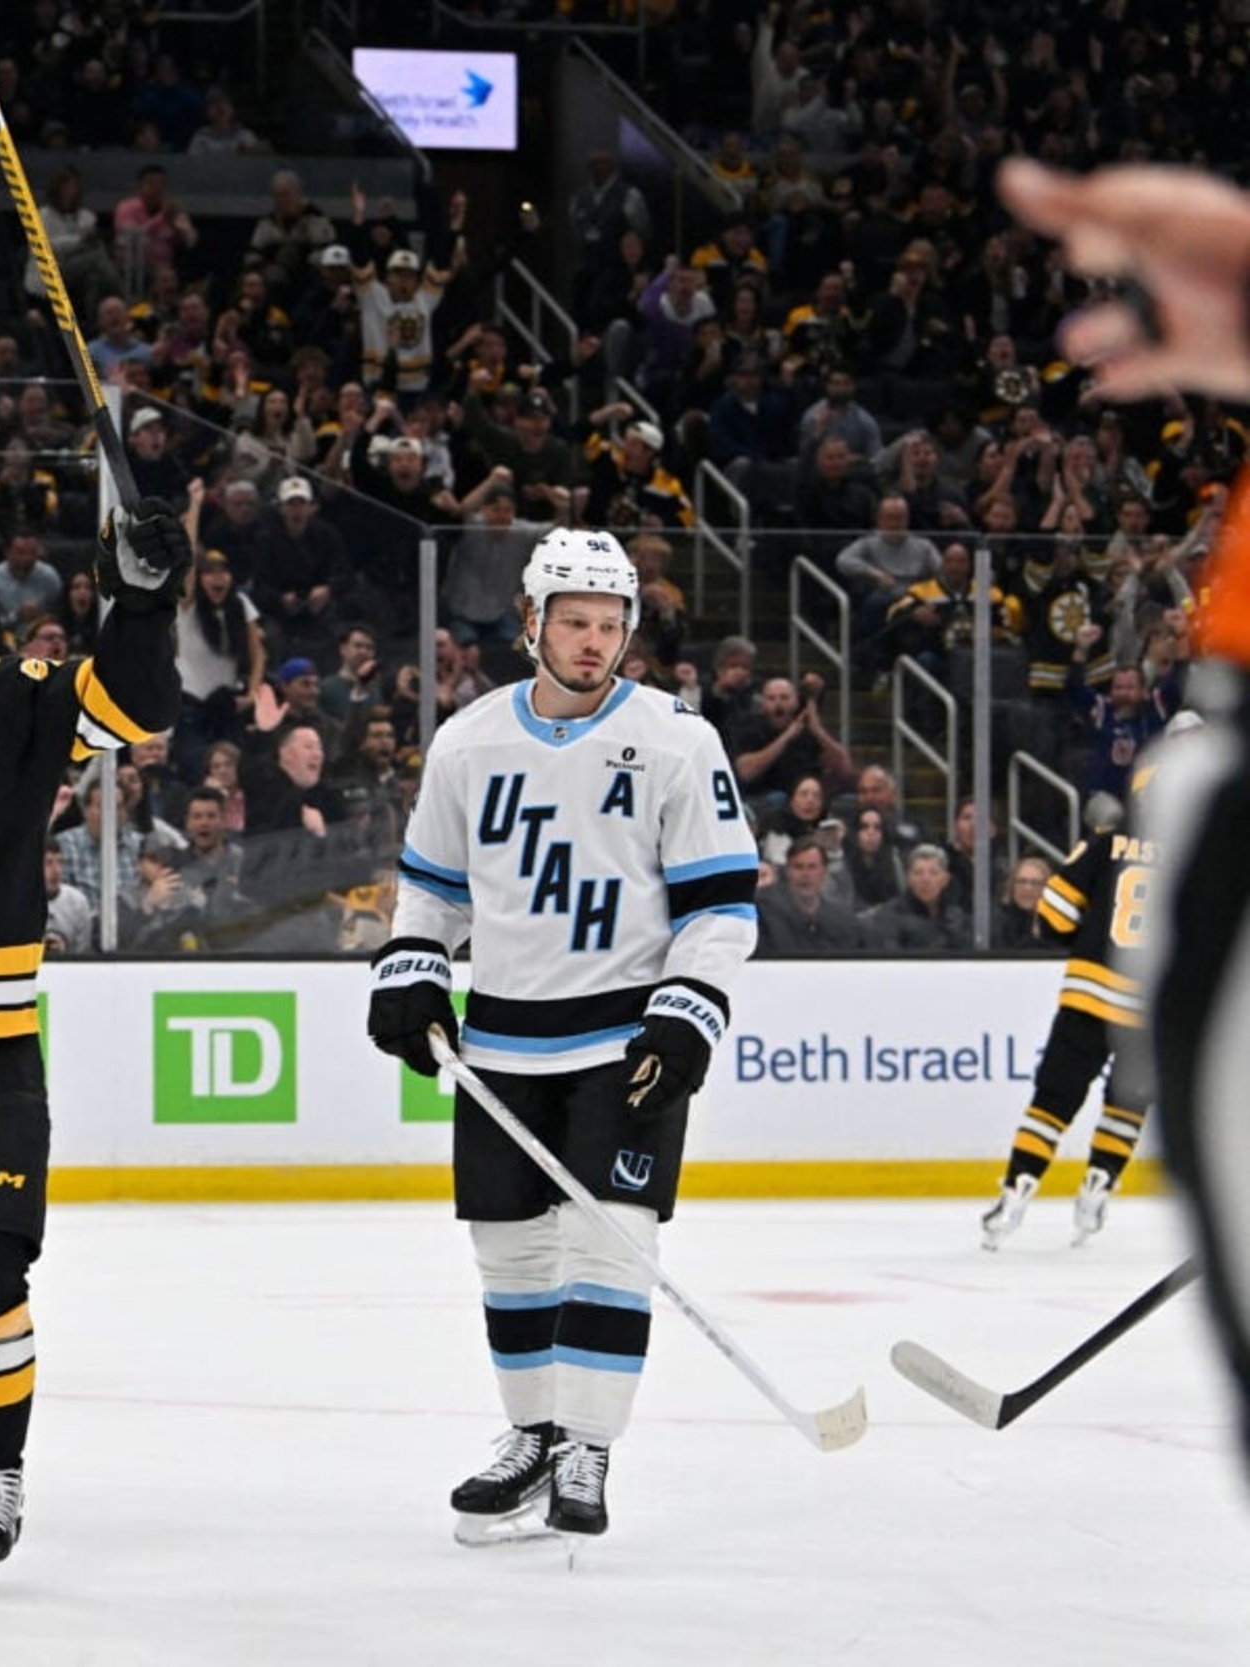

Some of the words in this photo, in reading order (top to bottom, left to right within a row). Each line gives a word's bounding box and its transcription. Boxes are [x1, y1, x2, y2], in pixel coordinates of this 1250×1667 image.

[600, 771, 635, 818] A
[477, 772, 623, 953] UTAH
[1109, 834, 1158, 863] PAS
[166, 1016, 284, 1098] TD
[736, 1033, 849, 1083] Beth
[864, 1033, 992, 1083] Israel
[1007, 1034, 1044, 1082] L
